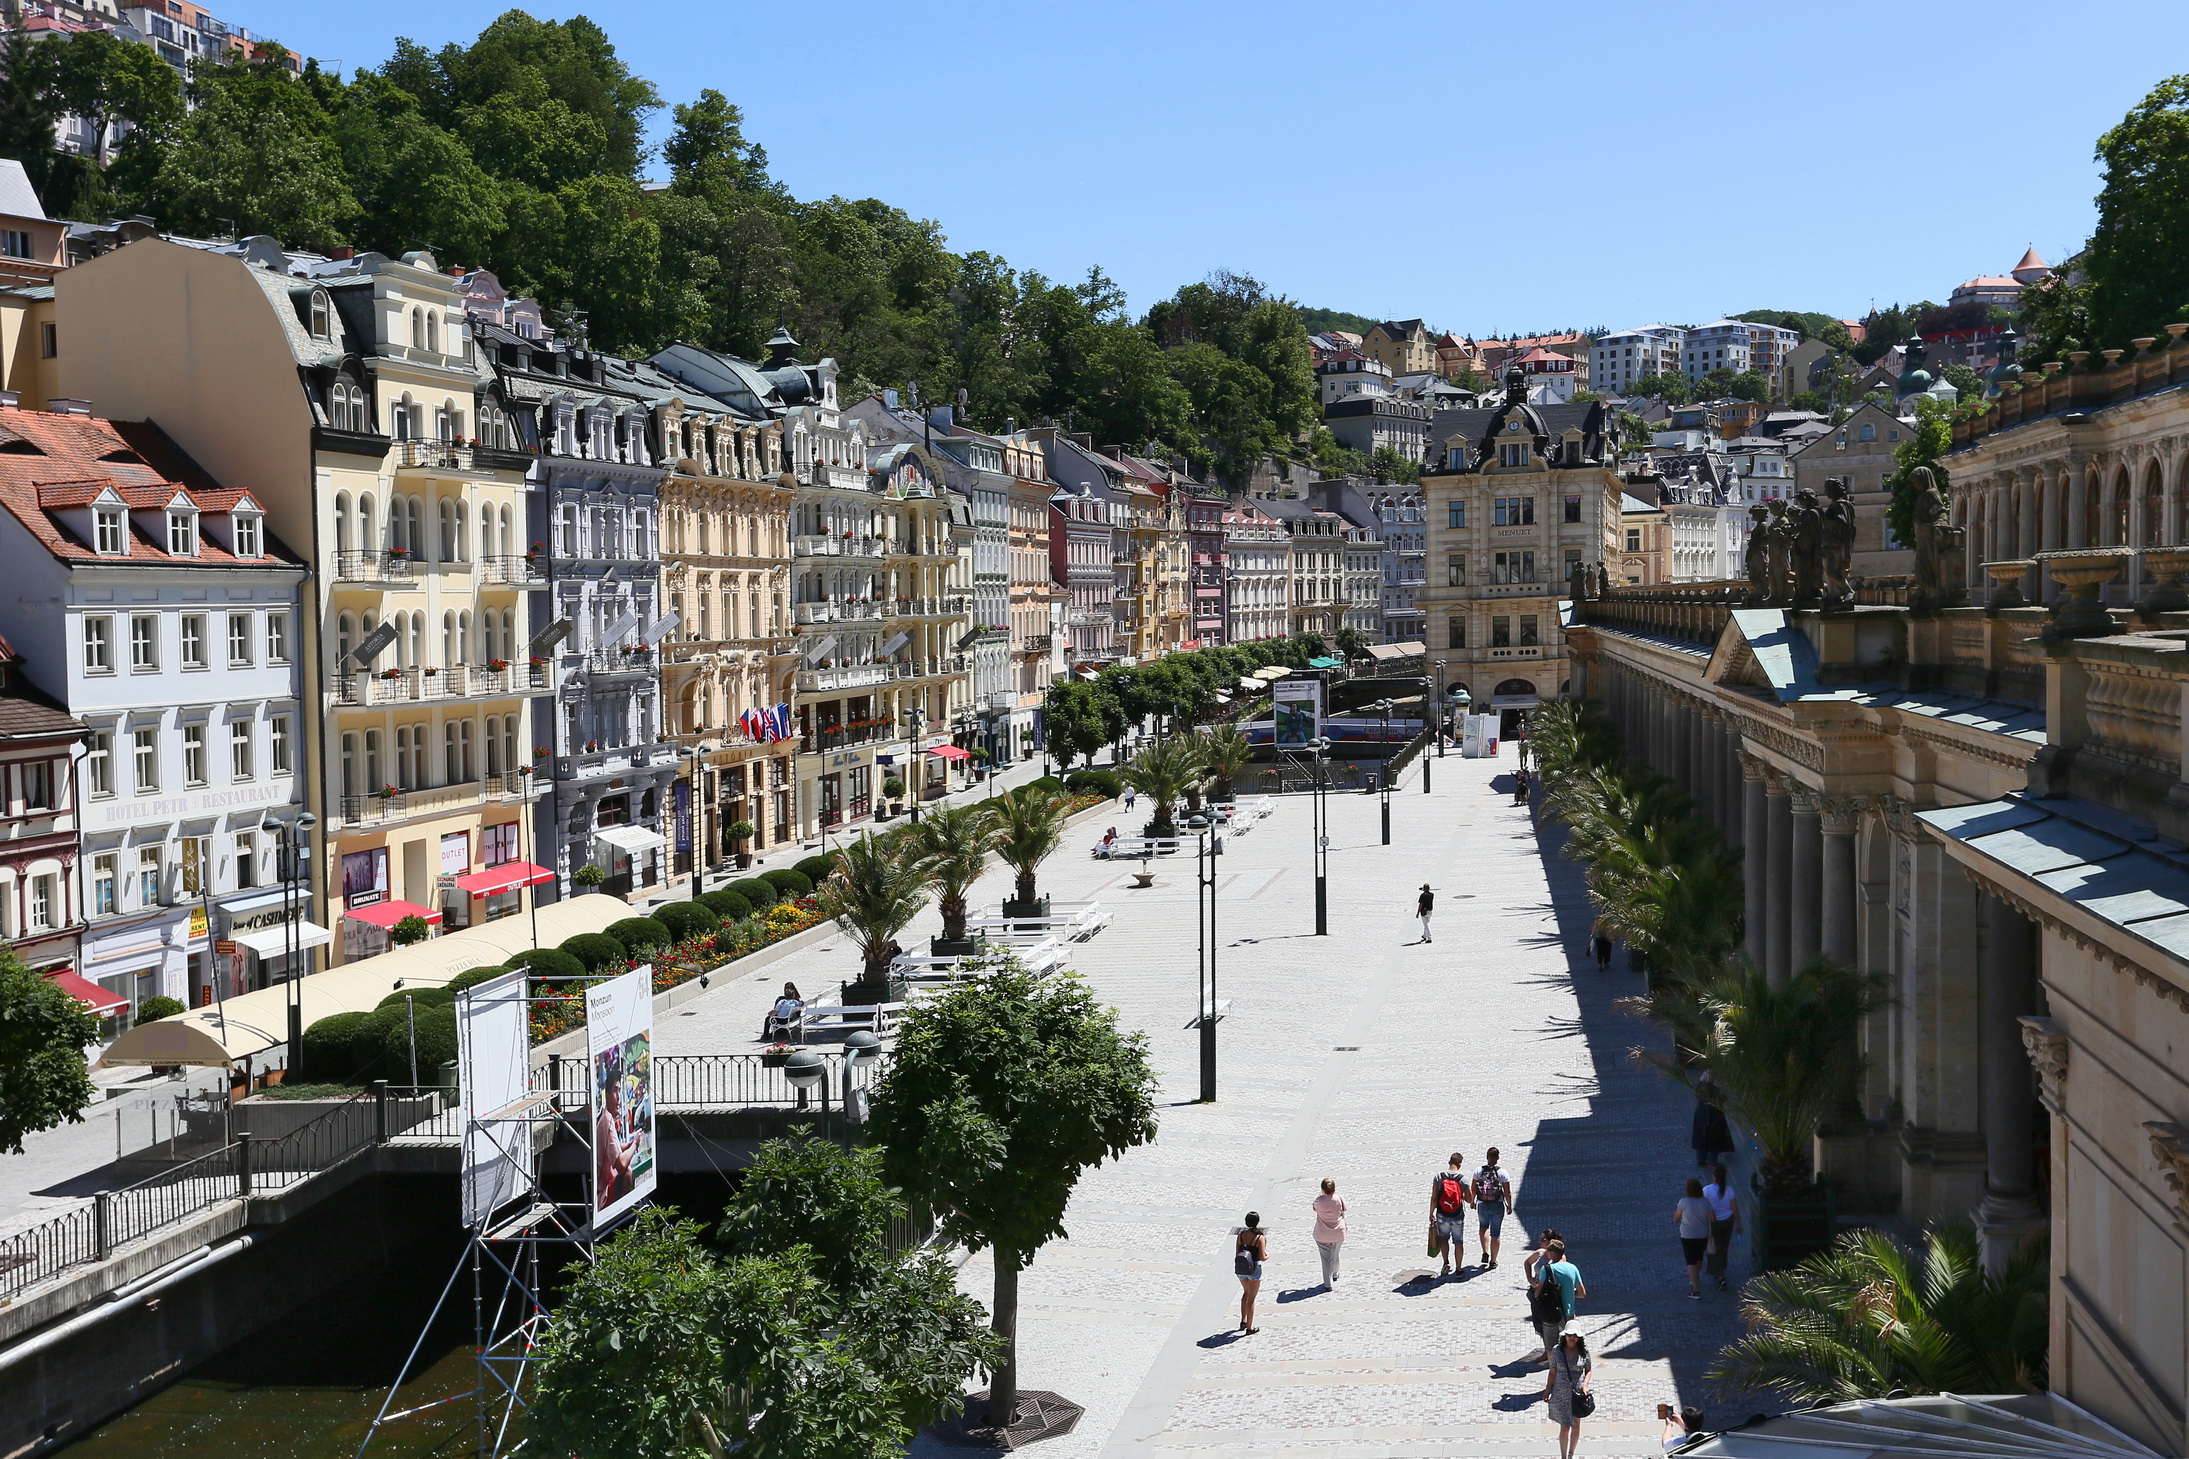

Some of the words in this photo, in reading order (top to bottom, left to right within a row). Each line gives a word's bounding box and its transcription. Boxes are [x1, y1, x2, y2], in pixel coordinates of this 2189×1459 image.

[1497, 529, 1532, 537] MENUET
[364, 633, 384, 651] ASTORIA
[712, 751, 753, 765] ASTORIA
[106, 802, 149, 822] HOTEL
[153, 797, 188, 816] PETR
[202, 785, 280, 808] RESTAURANT
[441, 847, 466, 859] OUTLET
[507, 881, 524, 891] OUTLET
[353, 893, 380, 905] BRUNATE
[445, 957, 484, 973] PIZZERIA
[590, 994, 613, 1009] Monzun
[591, 1006, 615, 1022] Monsoon
[135, 1099, 212, 1111] PIZZERIA
